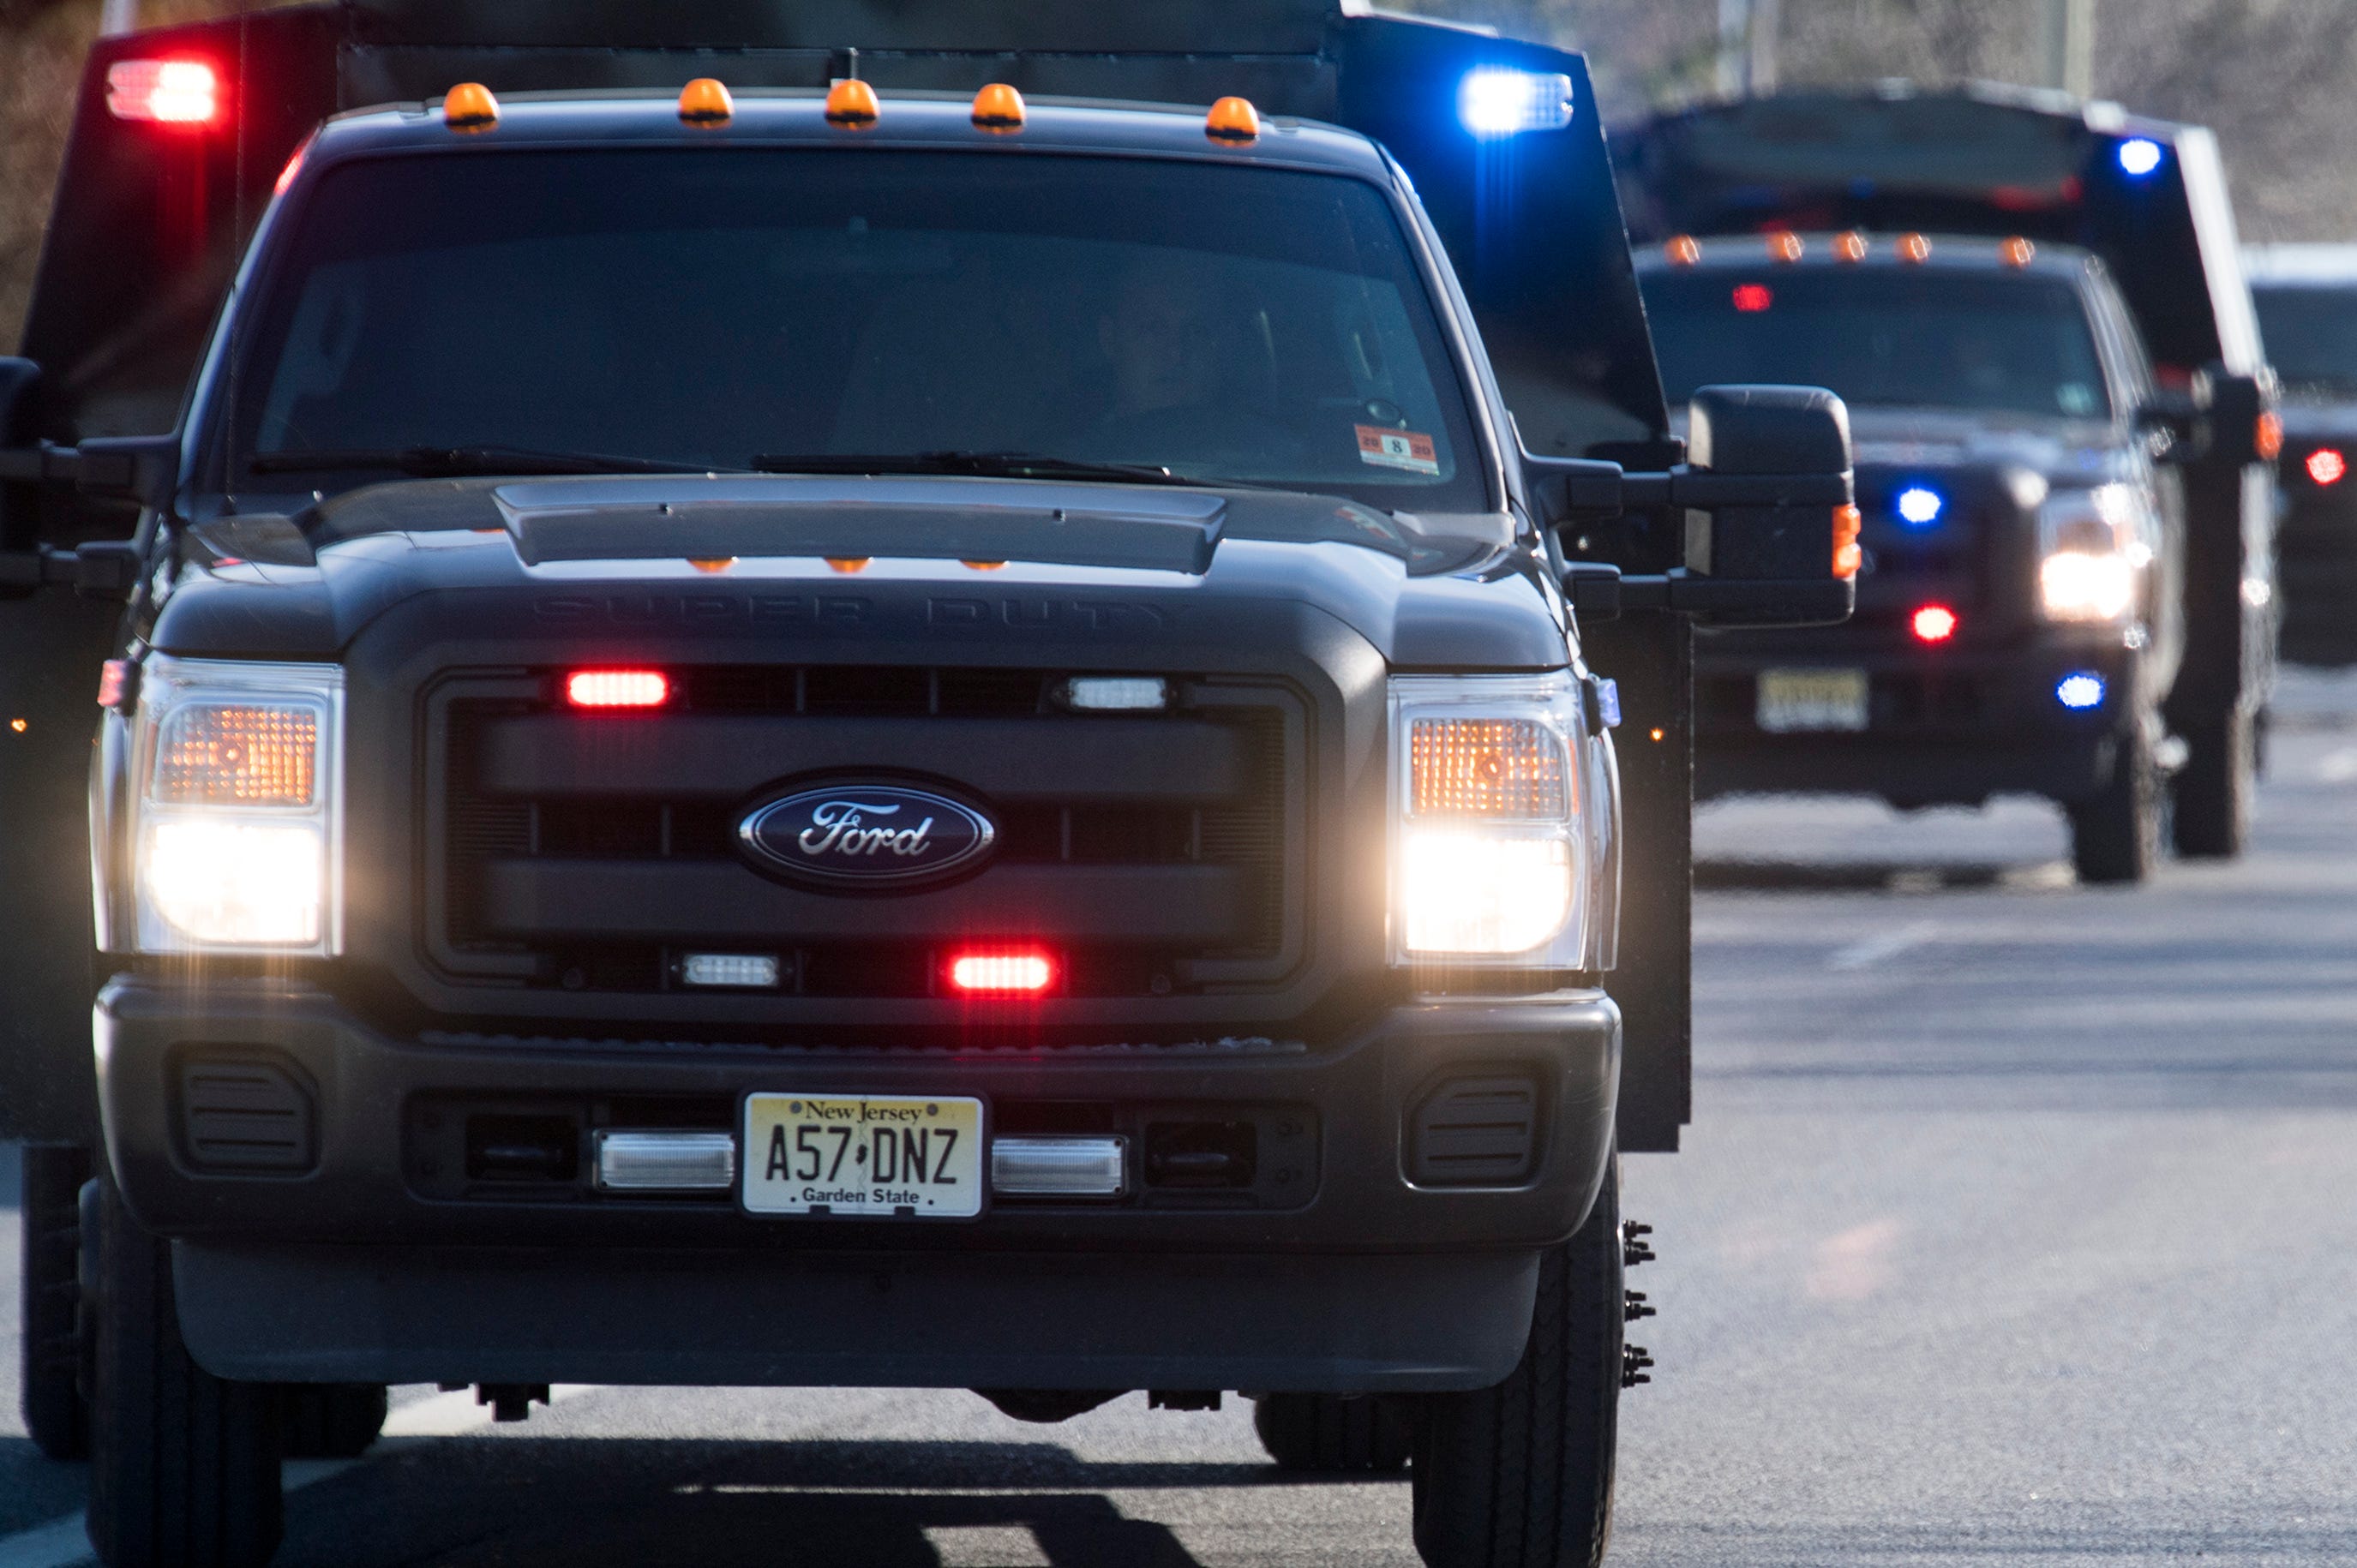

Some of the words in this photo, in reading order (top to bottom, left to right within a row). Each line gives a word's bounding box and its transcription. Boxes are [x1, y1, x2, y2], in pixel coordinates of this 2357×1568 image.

[1392, 439, 1403, 453] 8
[533, 595, 875, 626] SUPER
[926, 595, 1169, 631] DUTY
[798, 800, 934, 856] Ford
[805, 1101, 855, 1120] New
[856, 1102, 923, 1125] Jersey
[802, 1187, 866, 1203] Garden
[873, 1188, 921, 1204] State
